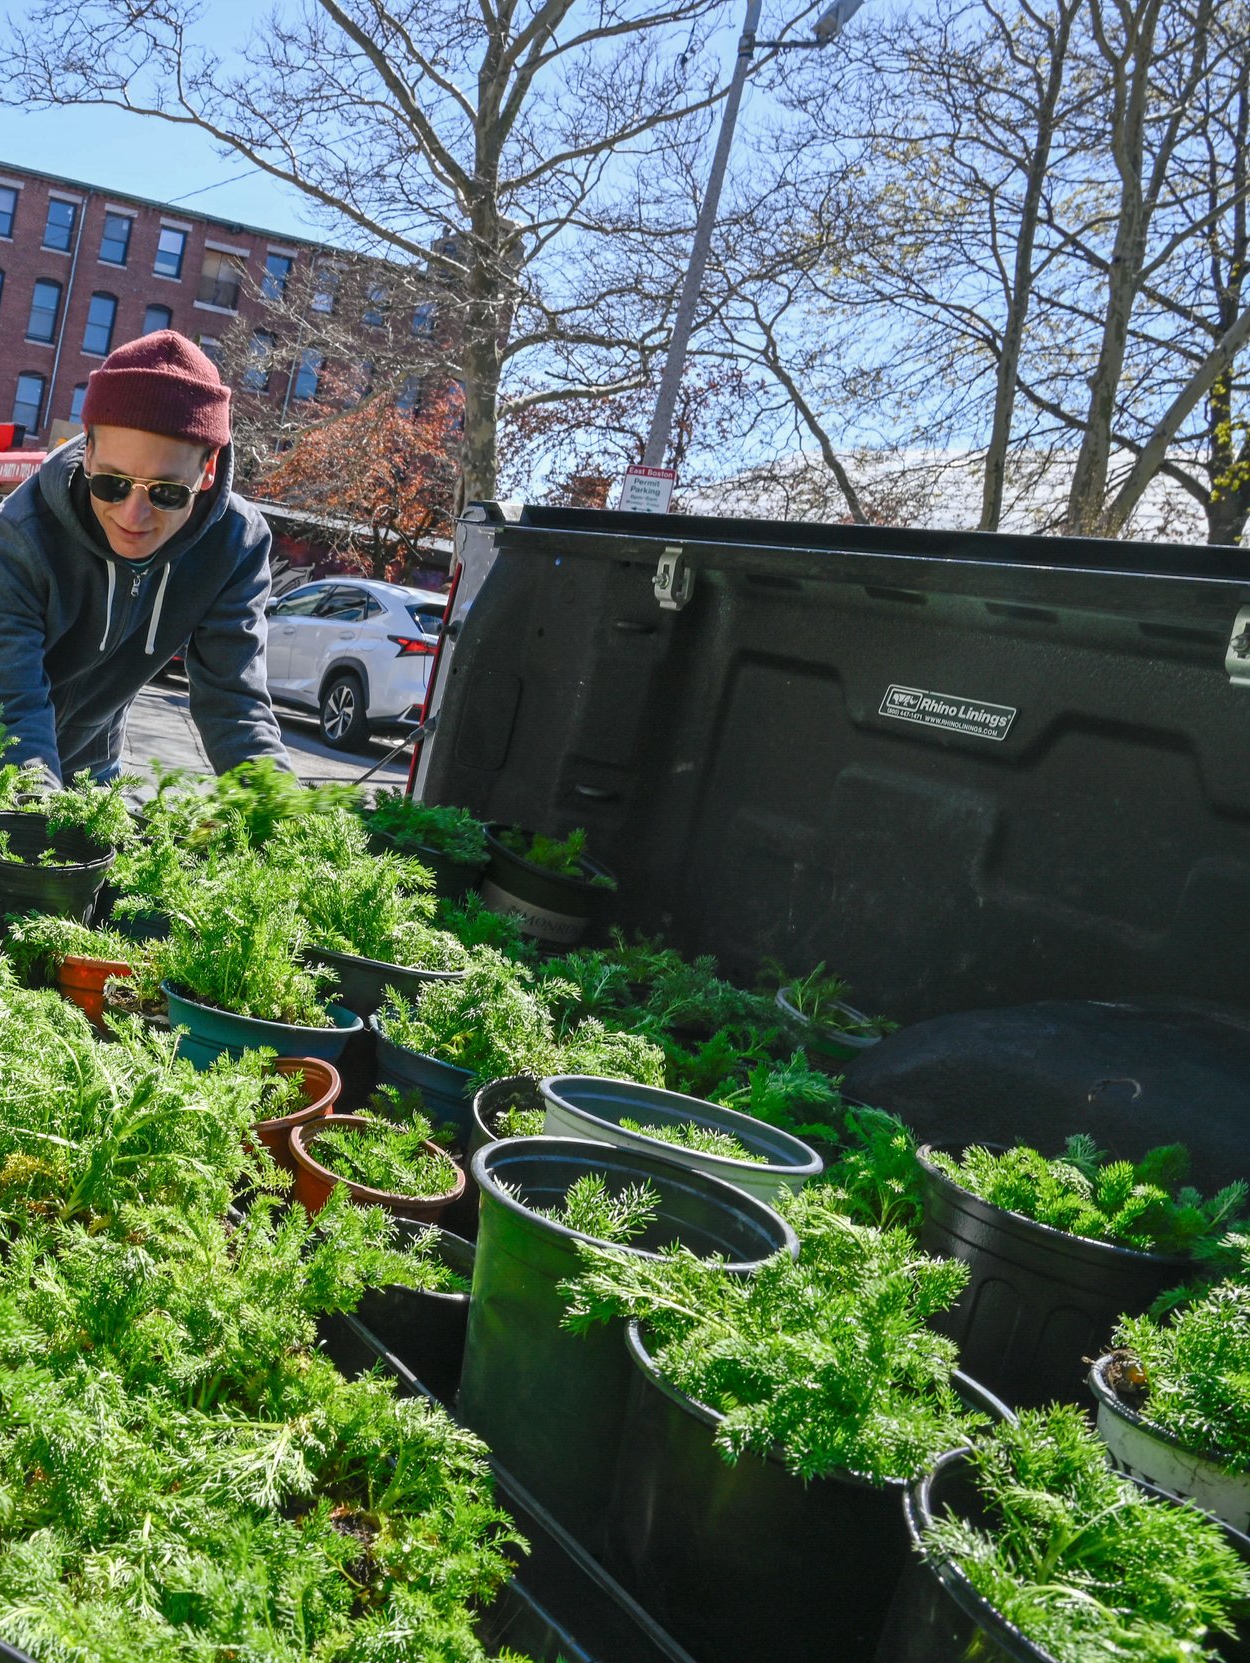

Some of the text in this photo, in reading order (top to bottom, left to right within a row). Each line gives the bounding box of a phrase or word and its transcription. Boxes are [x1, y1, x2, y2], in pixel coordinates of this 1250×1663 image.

[629, 466, 673, 478] East Boston
[633, 477, 660, 487] Permit
[630, 485, 661, 497] Parking
[919, 697, 958, 716] Rhino
[924, 715, 998, 737] WWW.RHINOLININGS.COM
